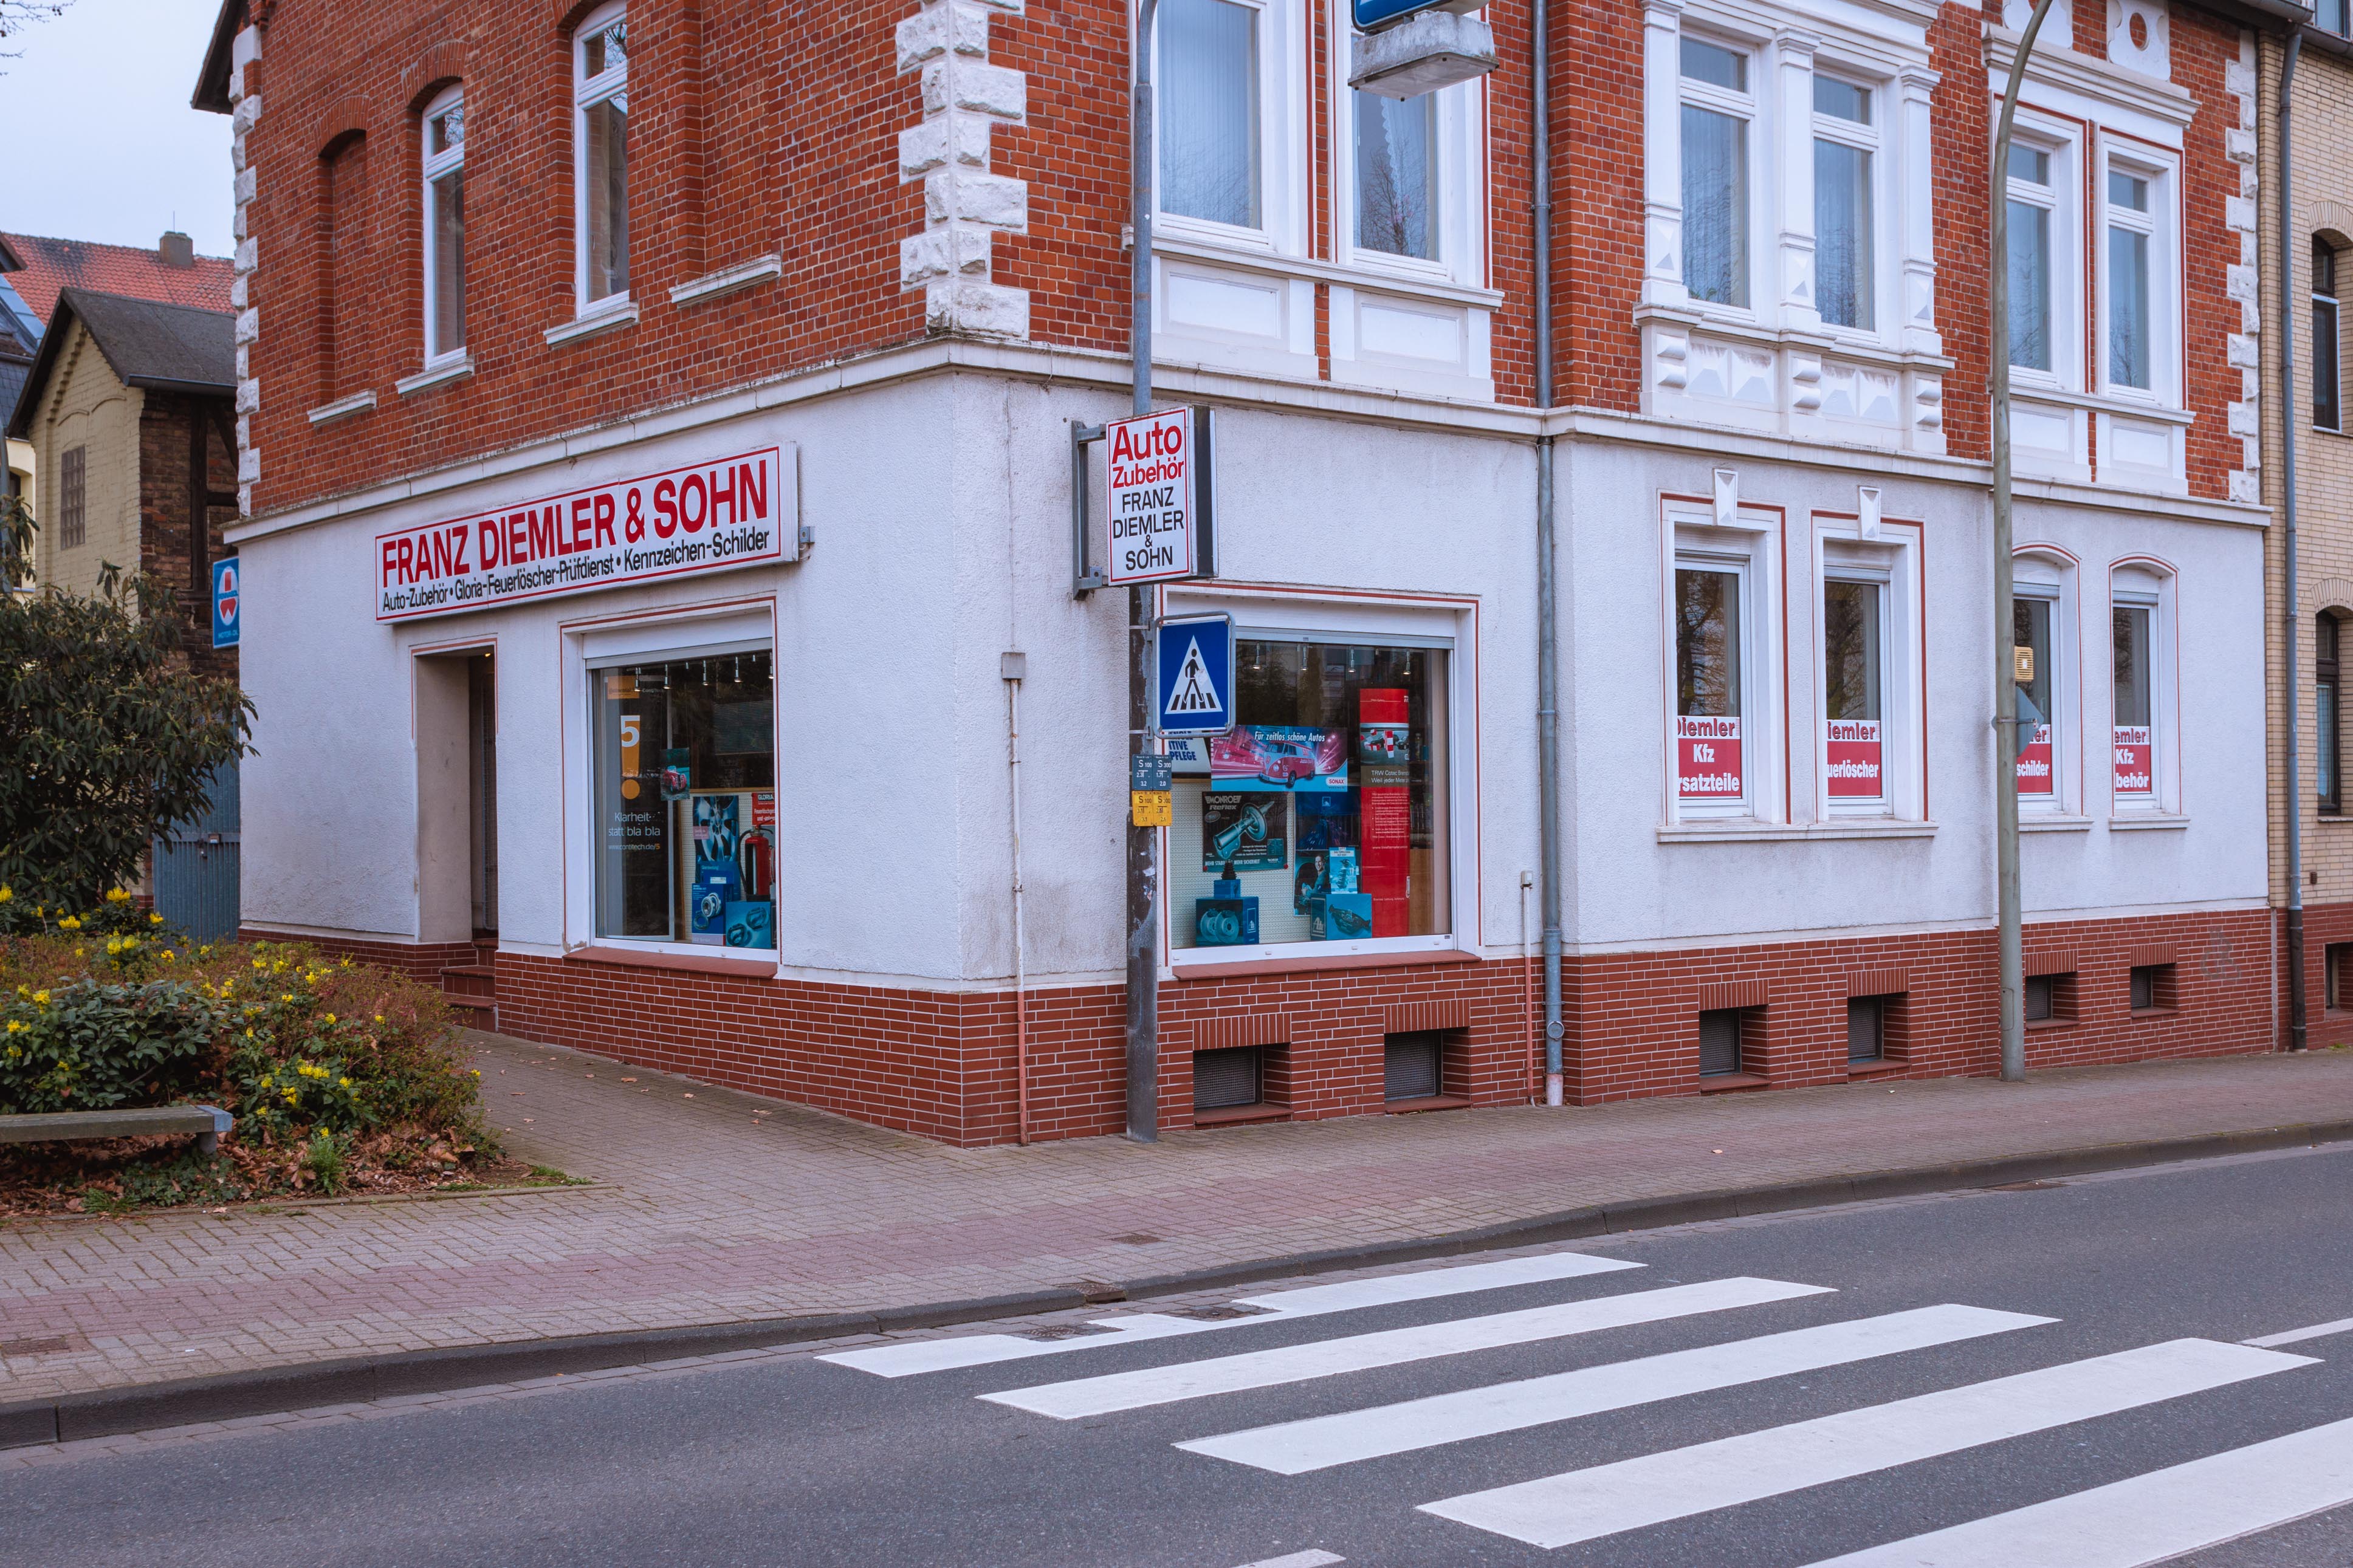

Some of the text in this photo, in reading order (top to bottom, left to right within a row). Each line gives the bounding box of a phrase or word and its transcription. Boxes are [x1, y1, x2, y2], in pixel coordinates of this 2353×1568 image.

[1111, 421, 1182, 464] Auto
[1113, 456, 1184, 488] Zubehör
[1122, 487, 1174, 513] FRANZ
[383, 459, 767, 588] FRANZ DIEMLER & SOHN
[1113, 510, 1184, 539] DIEMLER
[1145, 534, 1152, 547] &
[1125, 546, 1173, 570] SOHN
[383, 583, 448, 612] Auto-Zubehör
[624, 526, 769, 572] Kennzeichen-Schilder
[1254, 731, 1325, 742] Für zeitlos schöne Autos
[1169, 751, 1197, 761] PFLEGE
[1693, 744, 1715, 762] Kfz
[2116, 748, 2134, 765] Kfz
[1139, 759, 1144, 768] S
[1158, 759, 1163, 768] S
[2016, 759, 2049, 777] schilder
[2116, 772, 2149, 788] behör
[1207, 795, 1240, 804] MONROE
[614, 812, 650, 822] Klarheit
[608, 826, 661, 836] statt bla bla
